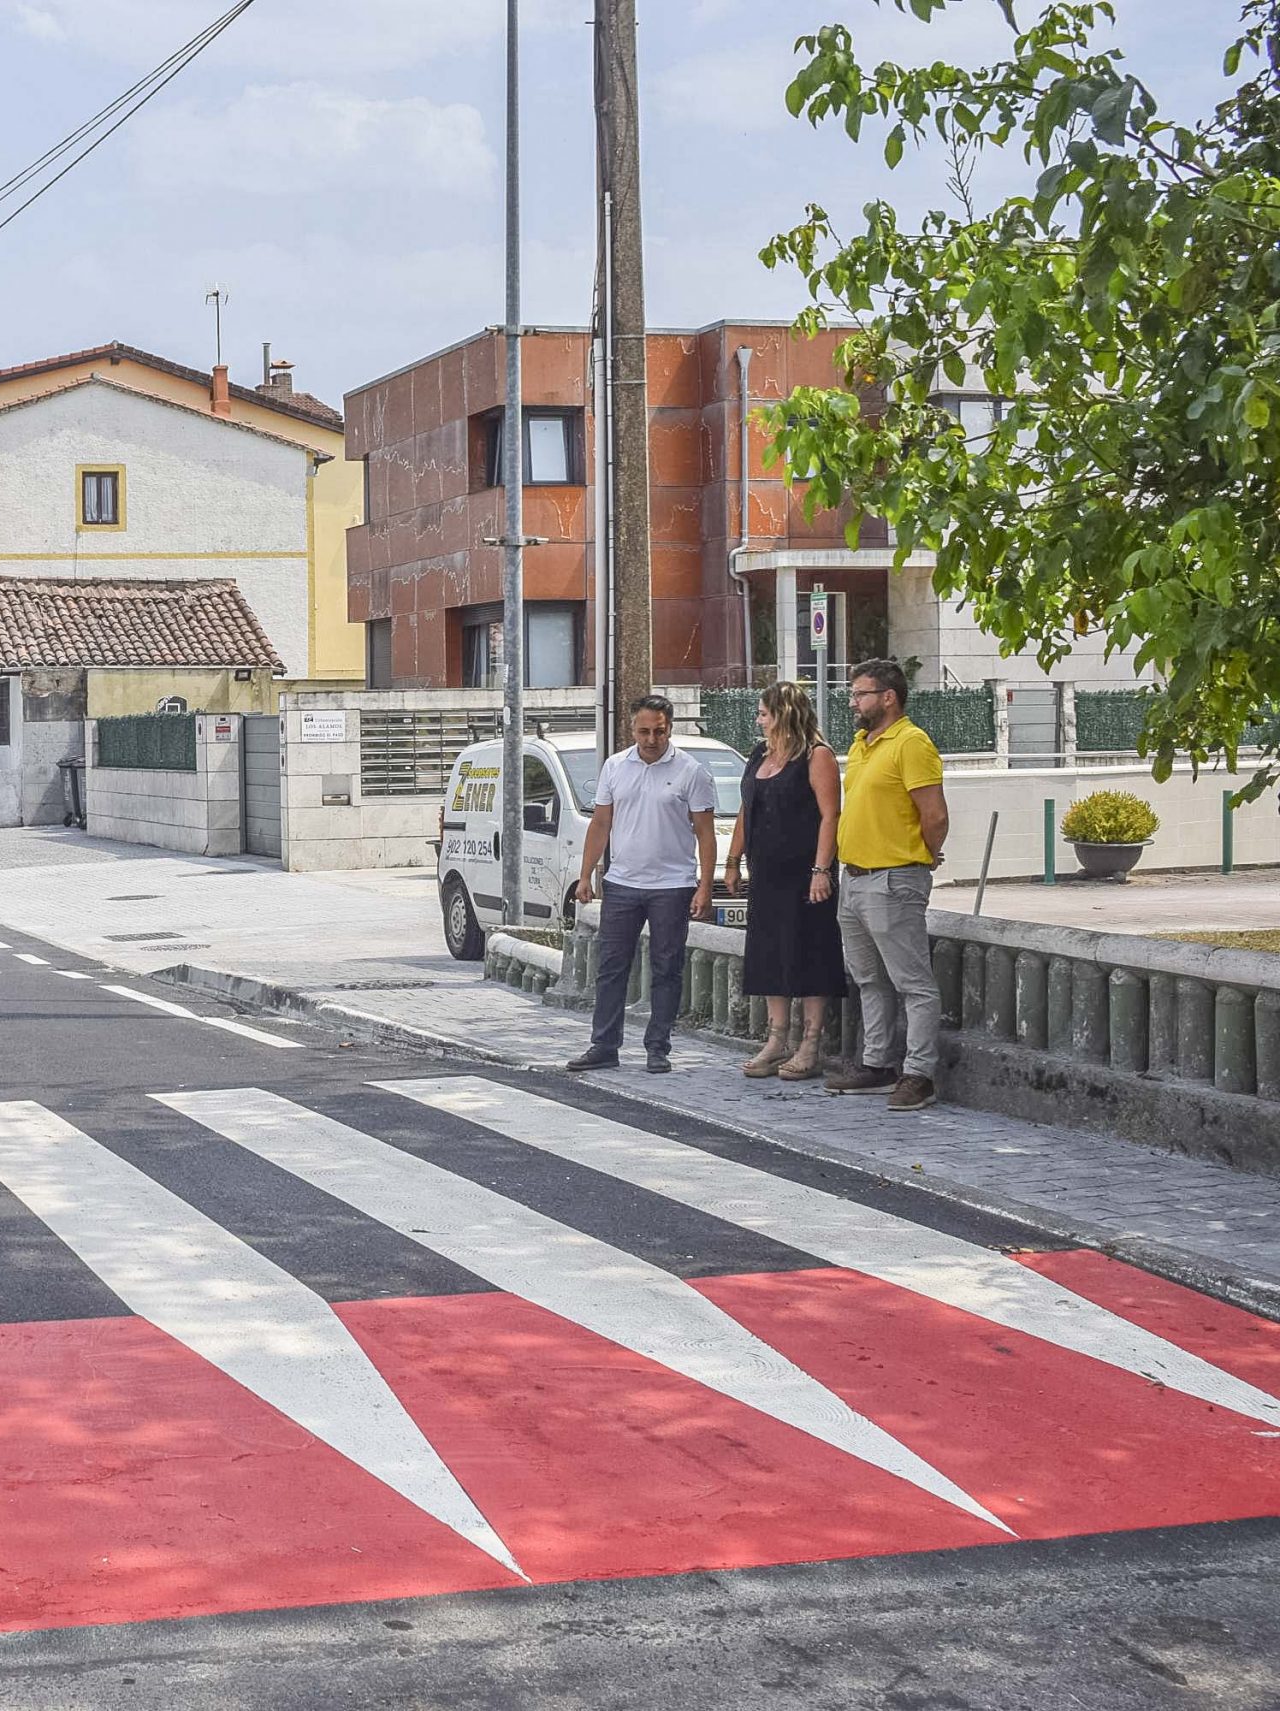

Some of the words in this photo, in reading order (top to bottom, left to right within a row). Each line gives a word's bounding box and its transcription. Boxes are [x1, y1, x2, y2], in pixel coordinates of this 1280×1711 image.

[447, 839, 461, 854] 902
[463, 839, 477, 855] 120
[478, 840, 492, 856] 254
[727, 909, 746, 923] 90
